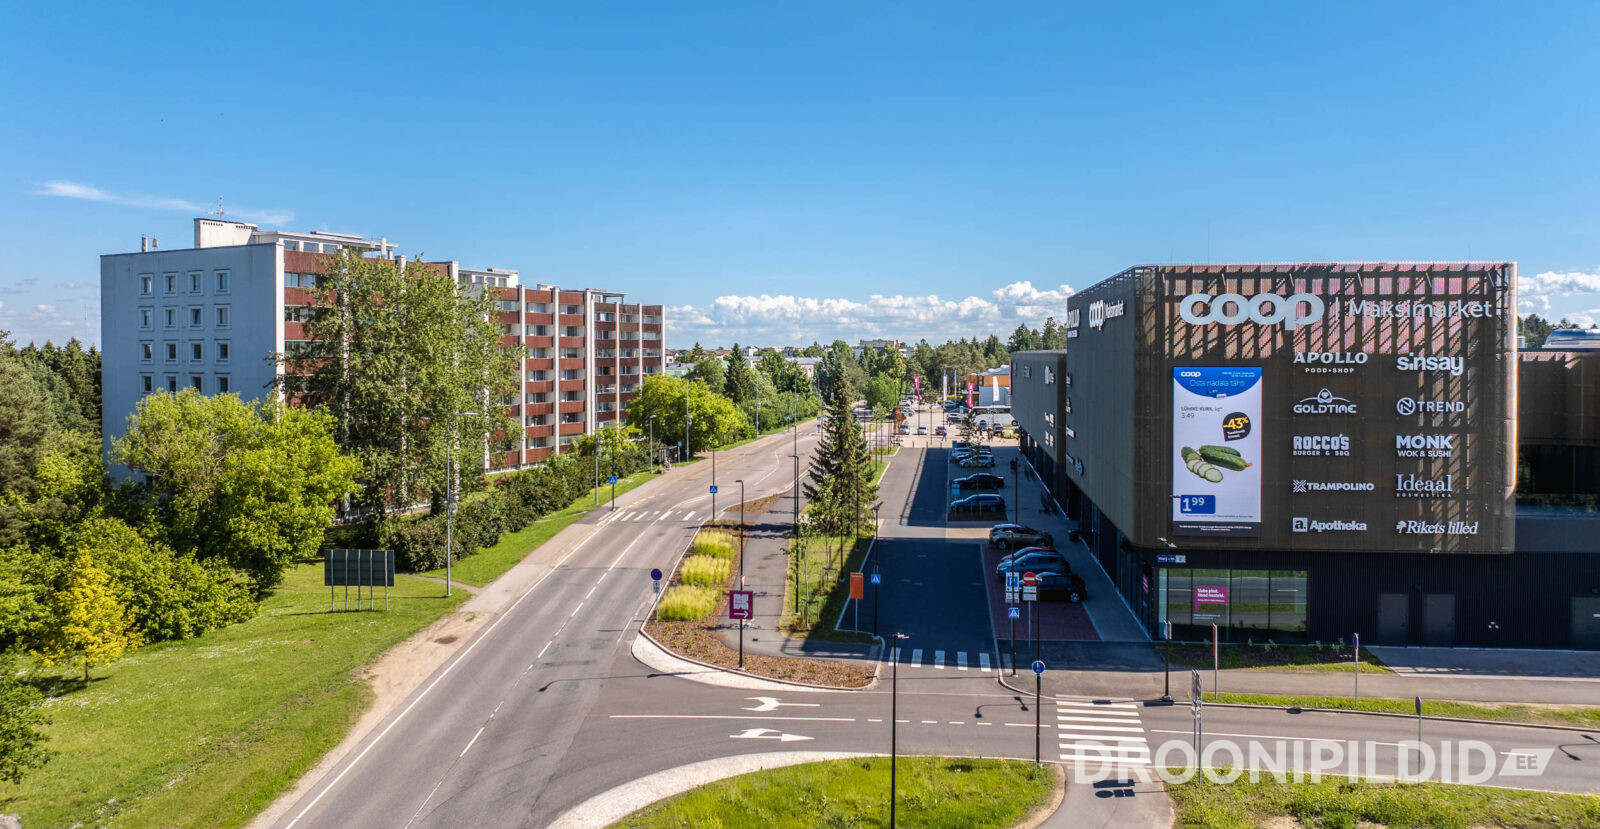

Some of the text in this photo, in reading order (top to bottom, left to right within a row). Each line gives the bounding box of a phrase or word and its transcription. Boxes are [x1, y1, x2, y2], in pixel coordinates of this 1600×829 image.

[1089, 299, 1104, 331] coop
[1179, 293, 1493, 330] coop Maksimarket
[1293, 352, 1368, 364] APOLLO
[1396, 352, 1464, 376] sinsay
[1293, 404, 1357, 413] GOLDTIME
[1417, 401, 1465, 412] TREND
[1396, 435, 1453, 449] MONK
[1306, 482, 1375, 491] TRAMPOLINO
[1396, 473, 1453, 492] Ideaal
[1309, 520, 1367, 533] Apotheka
[1405, 520, 1479, 535] Rikets lilled
